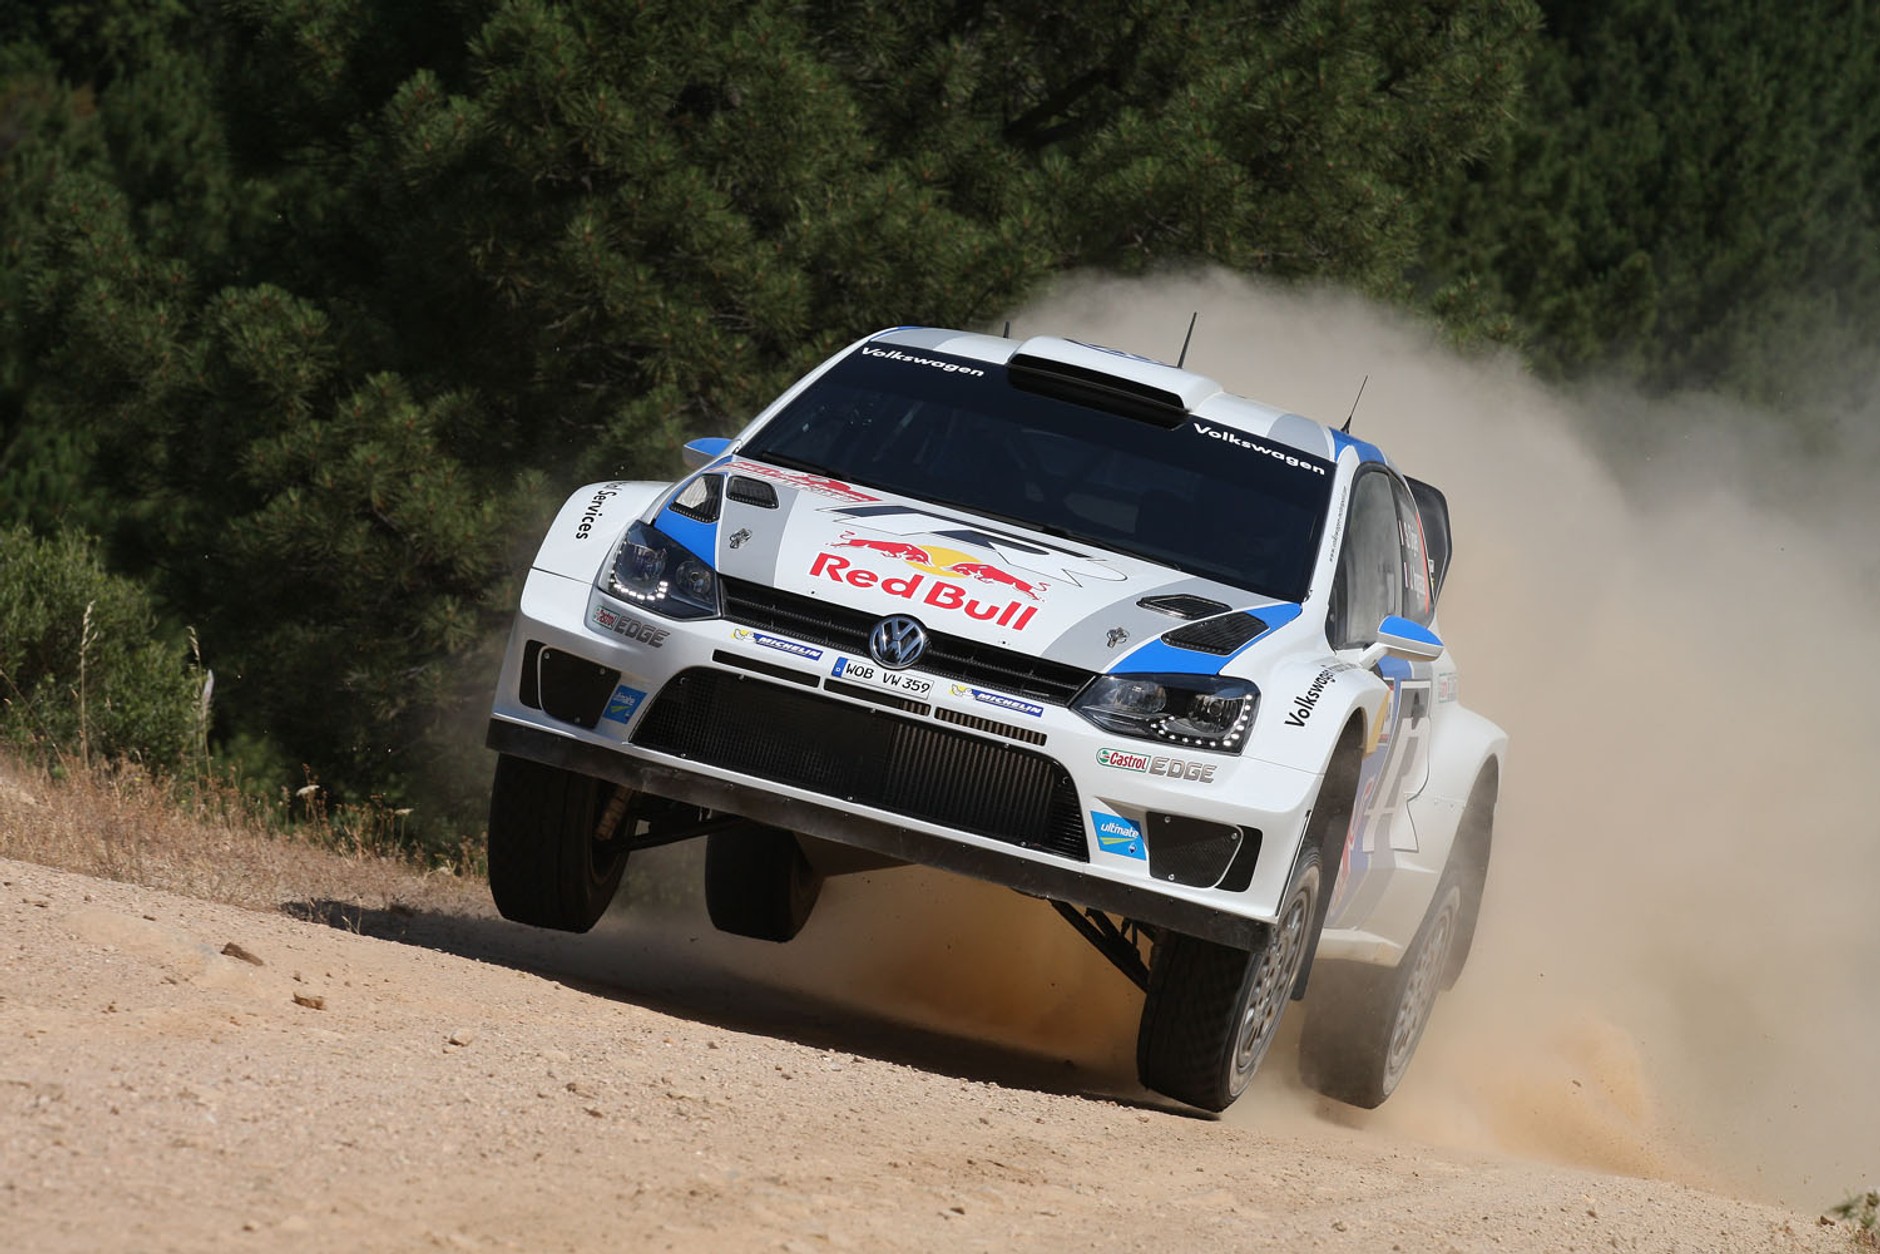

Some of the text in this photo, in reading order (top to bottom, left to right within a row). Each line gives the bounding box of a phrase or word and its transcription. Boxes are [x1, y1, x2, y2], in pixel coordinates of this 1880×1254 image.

[862, 347, 984, 377] Volkswagen
[1193, 422, 1325, 475] Volkswagen
[576, 490, 617, 540] Services
[809, 552, 1039, 631] Red Bull
[614, 616, 671, 649] EDGE
[758, 636, 821, 657] MICHELIN
[846, 663, 930, 694] WOB VW 359
[976, 693, 1042, 714] MICHELIN
[1110, 752, 1217, 783] Castrol EDGE
[1100, 822, 1139, 839] ultimate
